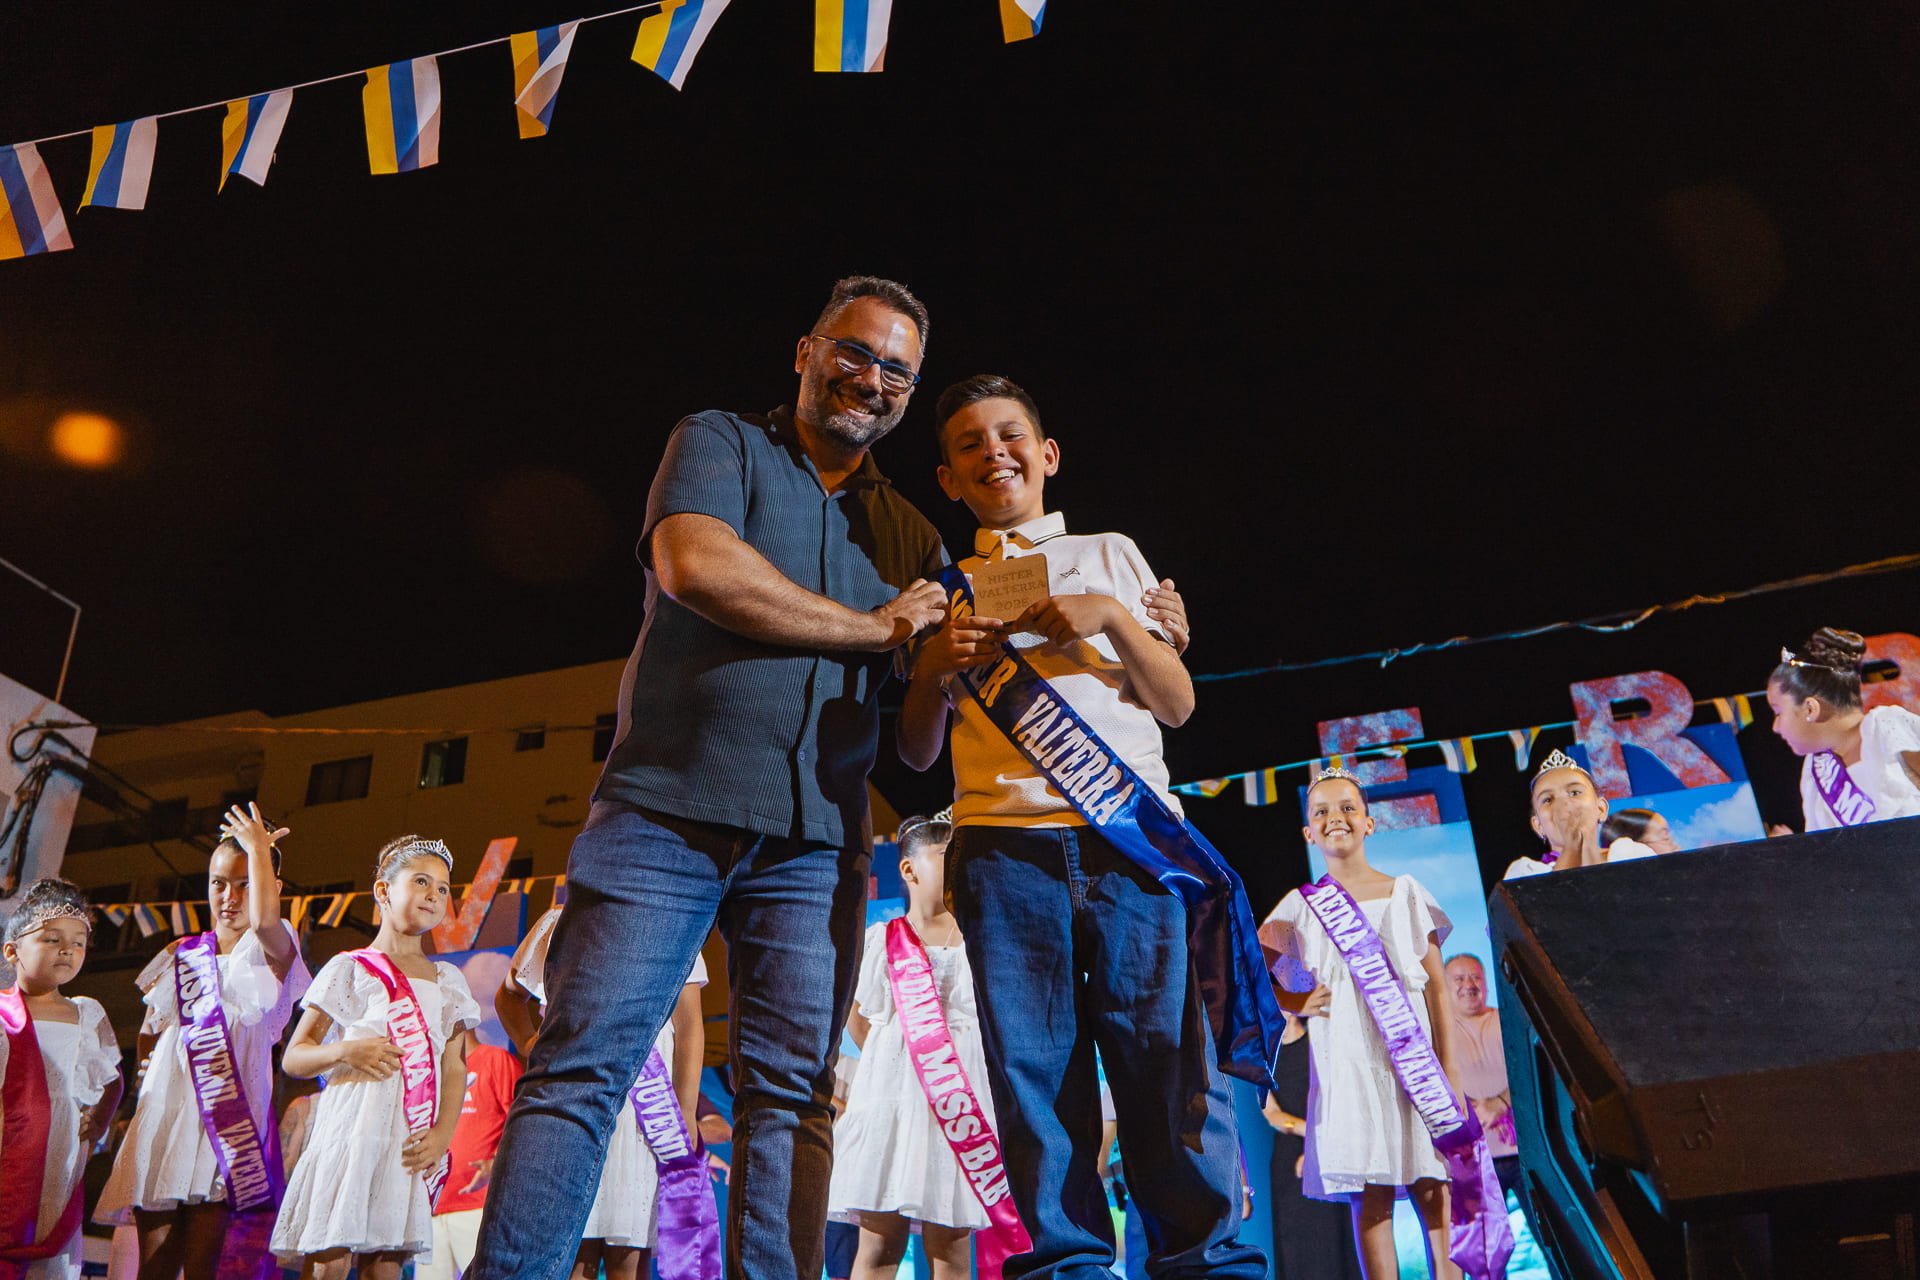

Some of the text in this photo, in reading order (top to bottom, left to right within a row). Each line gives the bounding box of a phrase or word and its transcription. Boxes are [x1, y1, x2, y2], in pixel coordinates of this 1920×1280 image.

[979, 580, 1046, 599] VALTERRA
[1011, 692, 1134, 826] VALTERRA
[387, 996, 433, 1091] REINA
[897, 974, 945, 1043] DAMA
[1307, 884, 1463, 1139] REINA JUVENIL VALTERRA
[178, 943, 271, 1211] MISS JUVENIL VALTERRA
[633, 1075, 689, 1164] JUVENIL
[918, 1044, 981, 1142] MISS
